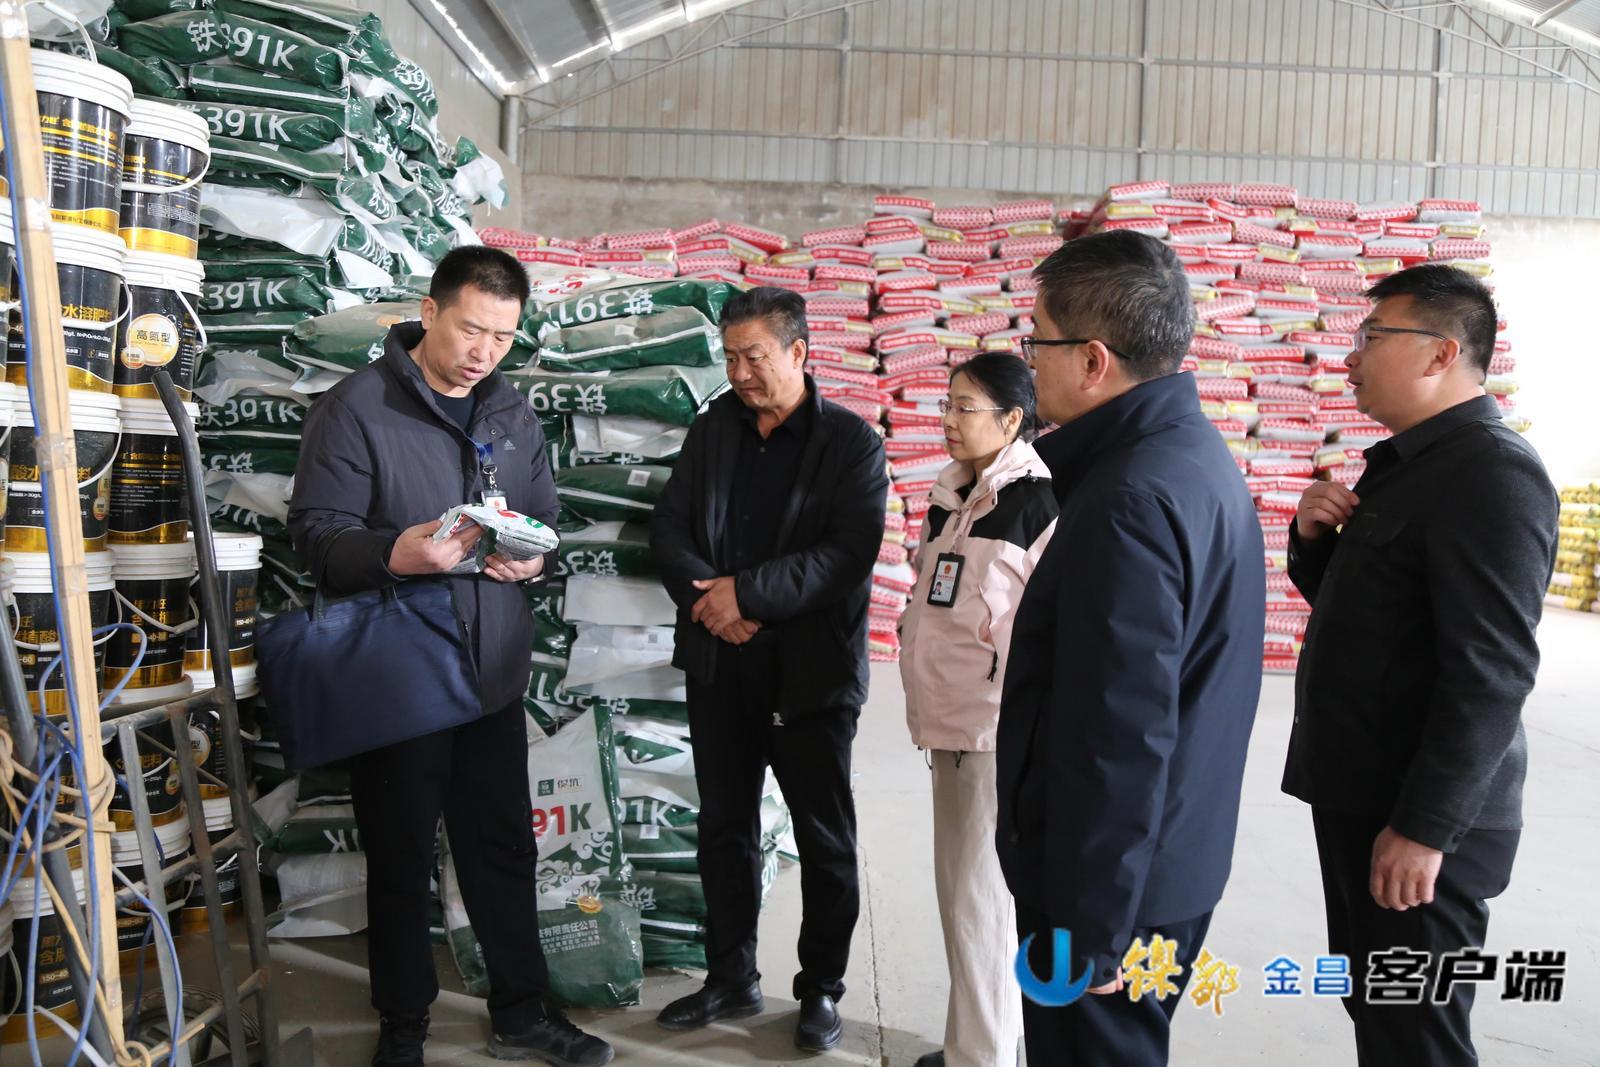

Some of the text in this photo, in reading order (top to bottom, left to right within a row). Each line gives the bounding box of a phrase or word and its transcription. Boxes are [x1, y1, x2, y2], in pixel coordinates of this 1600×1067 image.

[175, 103, 291, 144] 391K
[197, 277, 288, 312] 391K
[136, 329, 171, 343] 高氮型
[513, 381, 608, 415] 铁39
